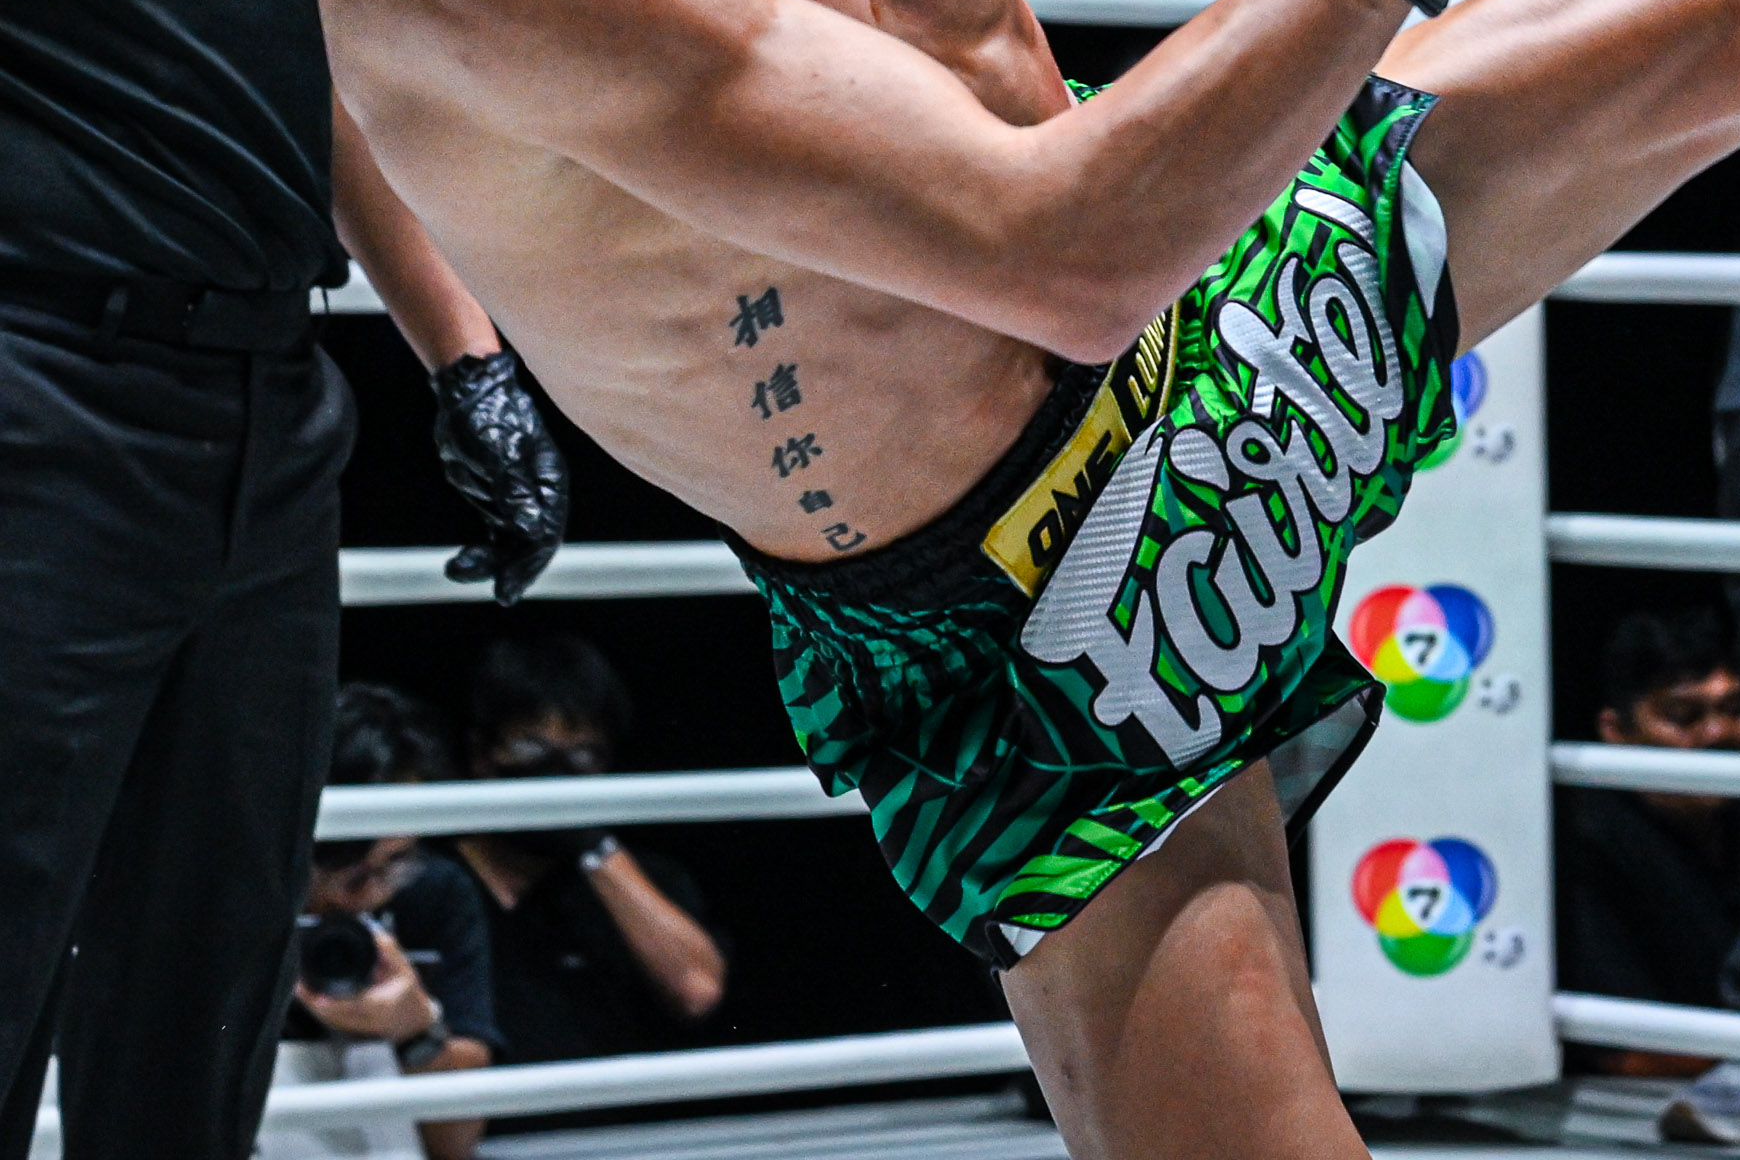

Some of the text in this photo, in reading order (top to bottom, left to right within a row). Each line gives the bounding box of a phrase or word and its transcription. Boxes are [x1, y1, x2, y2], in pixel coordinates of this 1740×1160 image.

[729, 286, 867, 551] 相信你自己
[1405, 632, 1438, 665] 7
[1406, 886, 1441, 920] 7
